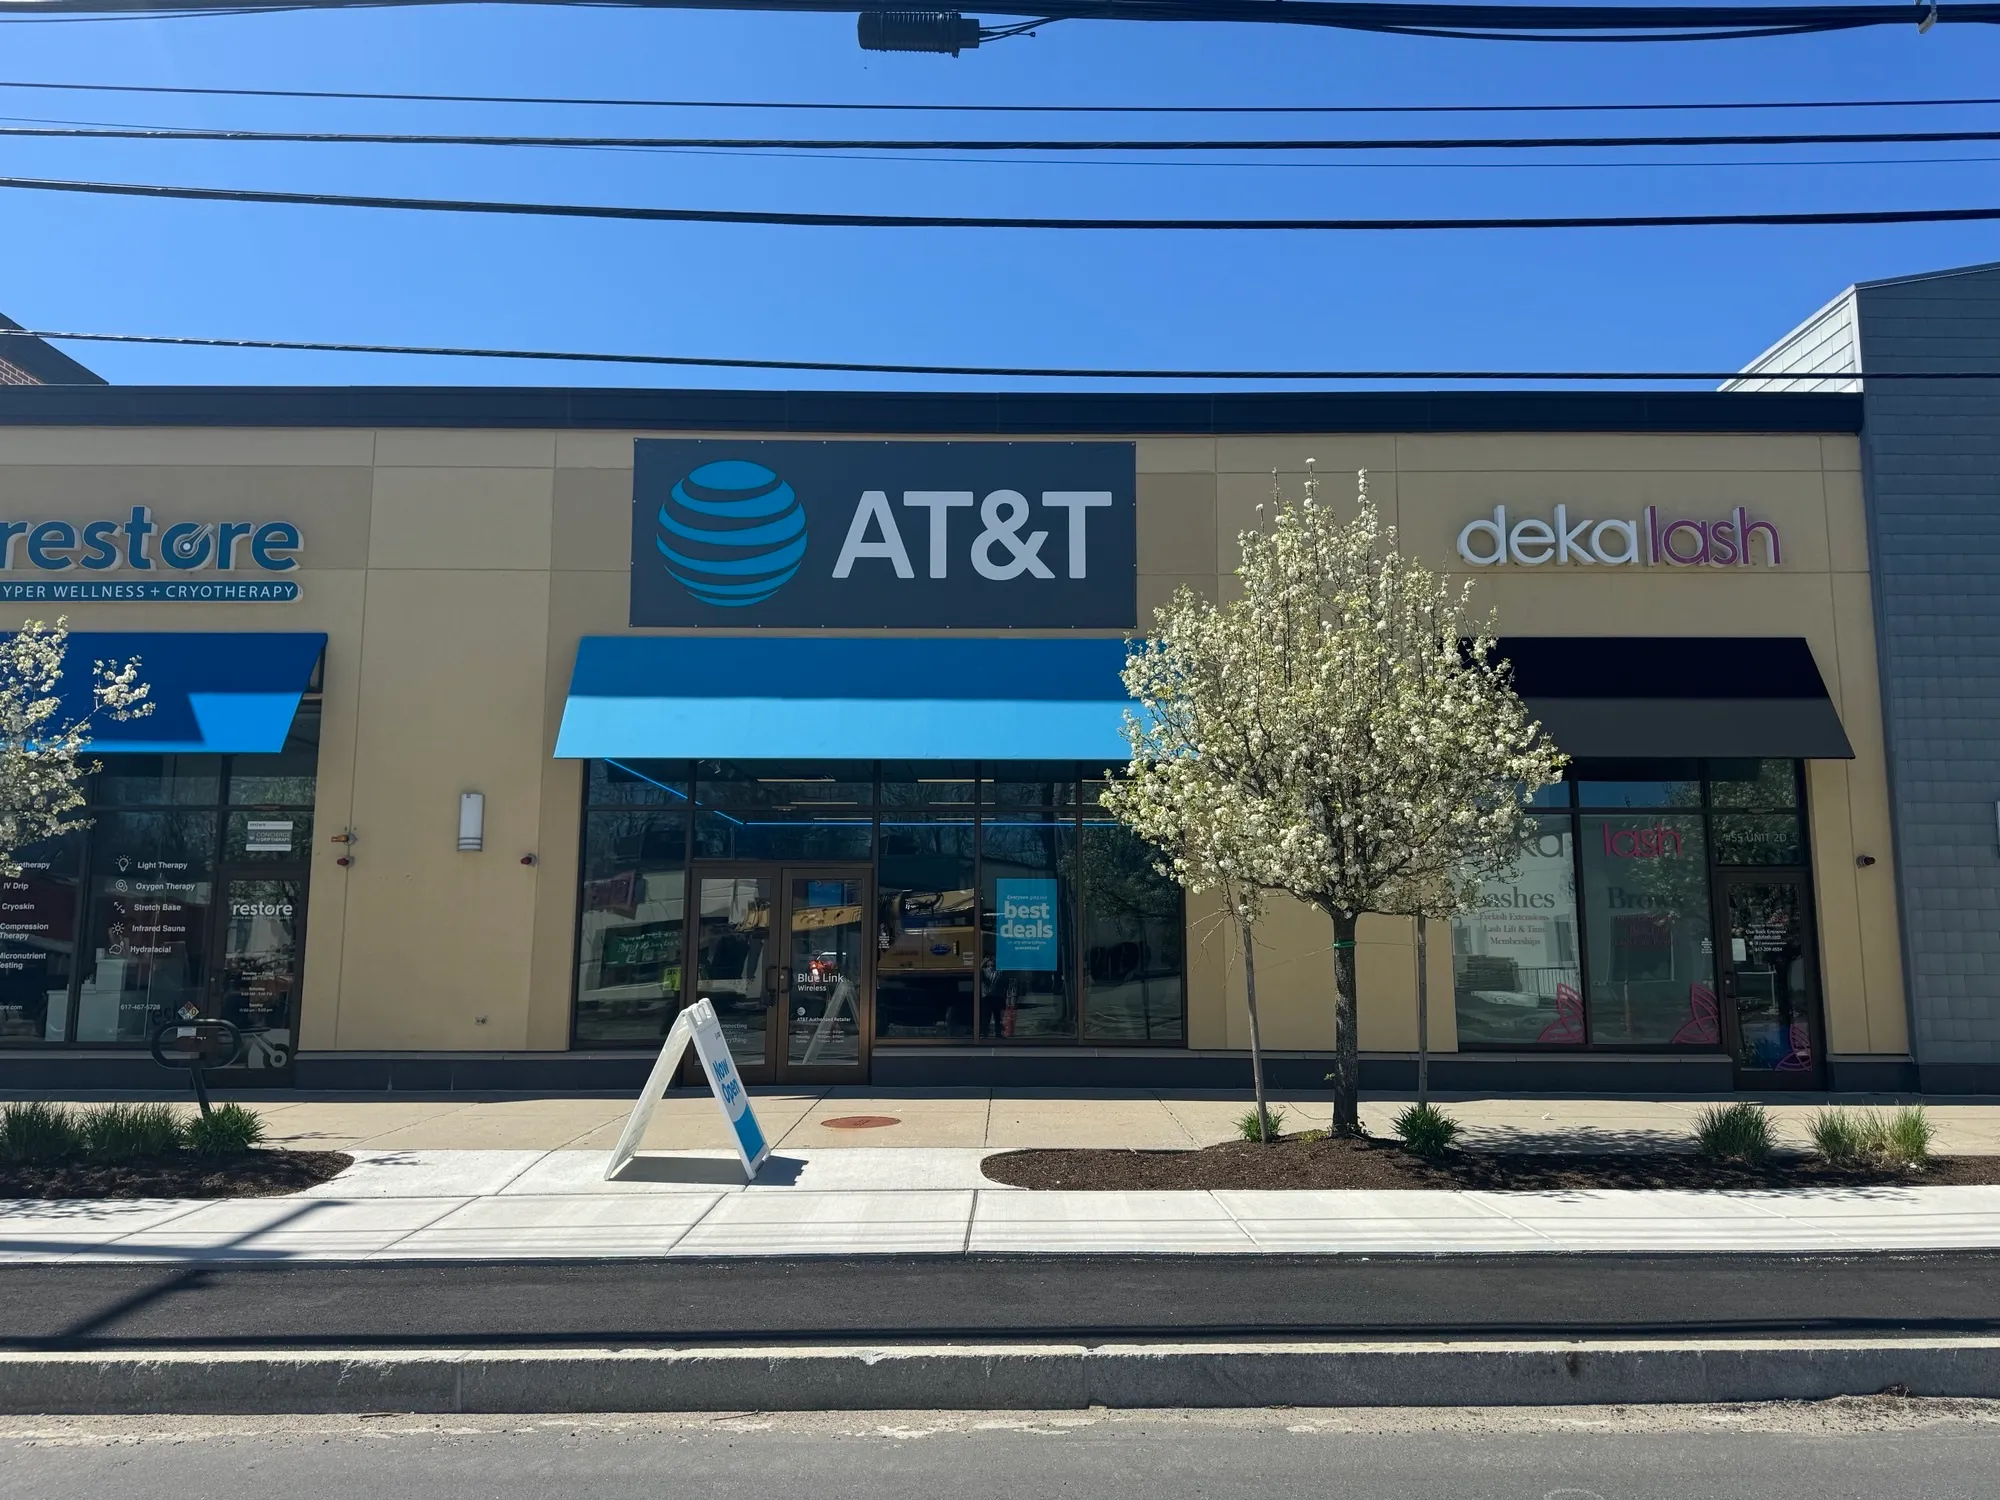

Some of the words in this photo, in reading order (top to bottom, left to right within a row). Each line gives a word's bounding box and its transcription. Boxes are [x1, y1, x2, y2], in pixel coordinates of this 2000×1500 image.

[0, 505, 304, 572] restore
[832, 489, 1113, 581] AT&T
[3, 585, 47, 598] YPER
[53, 585, 145, 598] WELLNESS
[166, 585, 295, 598] CRYOTHERAPY
[1603, 821, 1683, 859] lash
[1746, 830, 1770, 843] UNIT
[1773, 831, 1787, 843] 2D
[137, 861, 156, 870] Light
[158, 861, 188, 871] Therapy
[3, 882, 12, 890] IV
[13, 882, 29, 891] Drip
[136, 882, 164, 891] Oxygen
[166, 882, 196, 891] Therapy
[1478, 886, 1555, 909] ashes
[1, 902, 35, 911] Cryoskin
[134, 903, 161, 911] Stretch
[163, 903, 182, 911] Base
[232, 901, 293, 916] restore
[1004, 900, 1050, 919] best
[1479, 912, 1507, 923] Eyelash
[0, 922, 49, 932] Compression
[132, 924, 161, 932] Infrared
[162, 924, 186, 932] Sauna
[1000, 919, 1054, 938] deals
[1483, 924, 1502, 933] Lash
[1503, 924, 1517, 933] Lift
[0, 931, 29, 941] Therapy
[1489, 936, 1541, 948] Memberships
[130, 945, 172, 954] Hydrafacial
[0, 961, 24, 971] esting
[797, 972, 820, 983] Blue
[822, 972, 844, 983] Link
[797, 984, 827, 992] Wireless
[721, 1023, 748, 1031] onnecting
[713, 1058, 730, 1081] Now
[722, 1077, 741, 1106] Open
